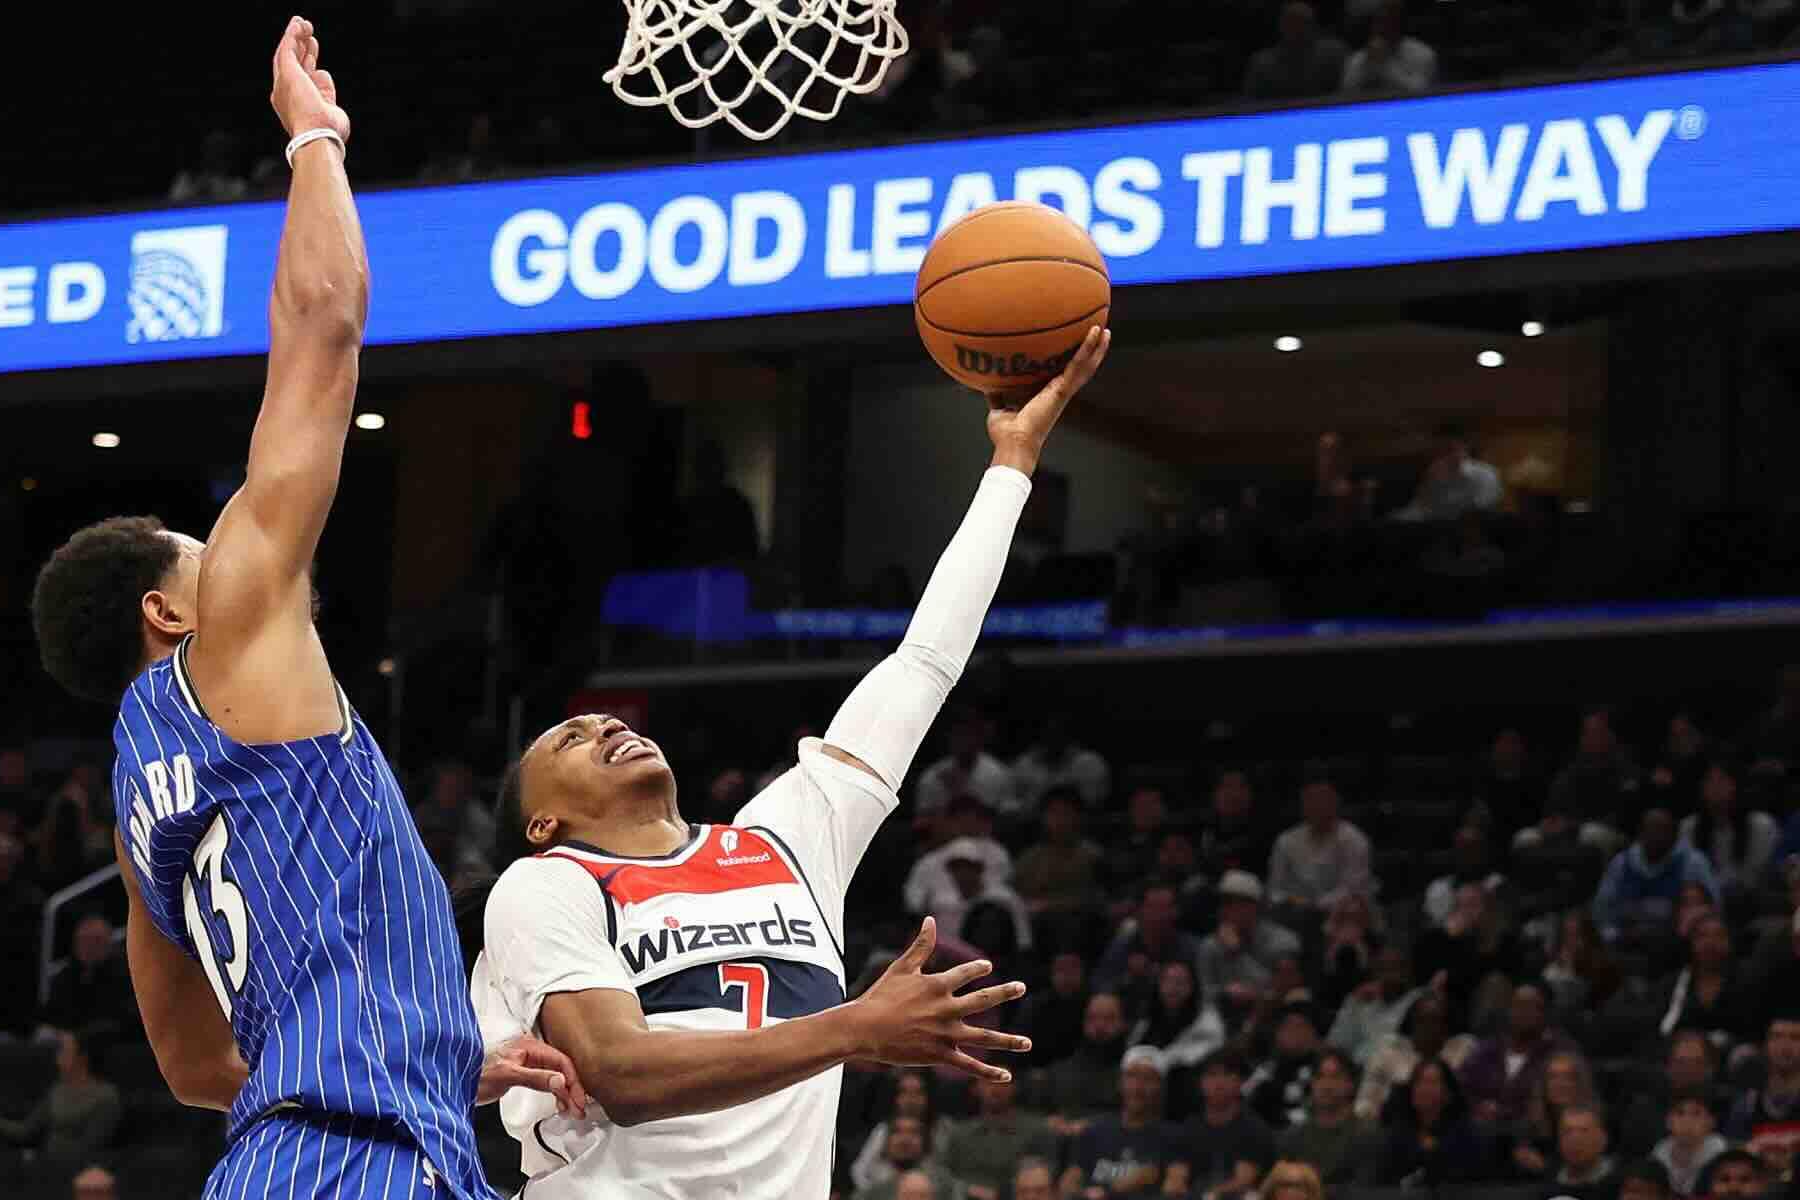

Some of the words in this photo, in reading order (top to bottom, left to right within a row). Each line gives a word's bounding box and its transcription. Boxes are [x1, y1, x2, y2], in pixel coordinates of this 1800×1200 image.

[491, 191, 807, 306] GOOD
[1181, 136, 1389, 248] THE
[717, 961, 771, 1031] 7
